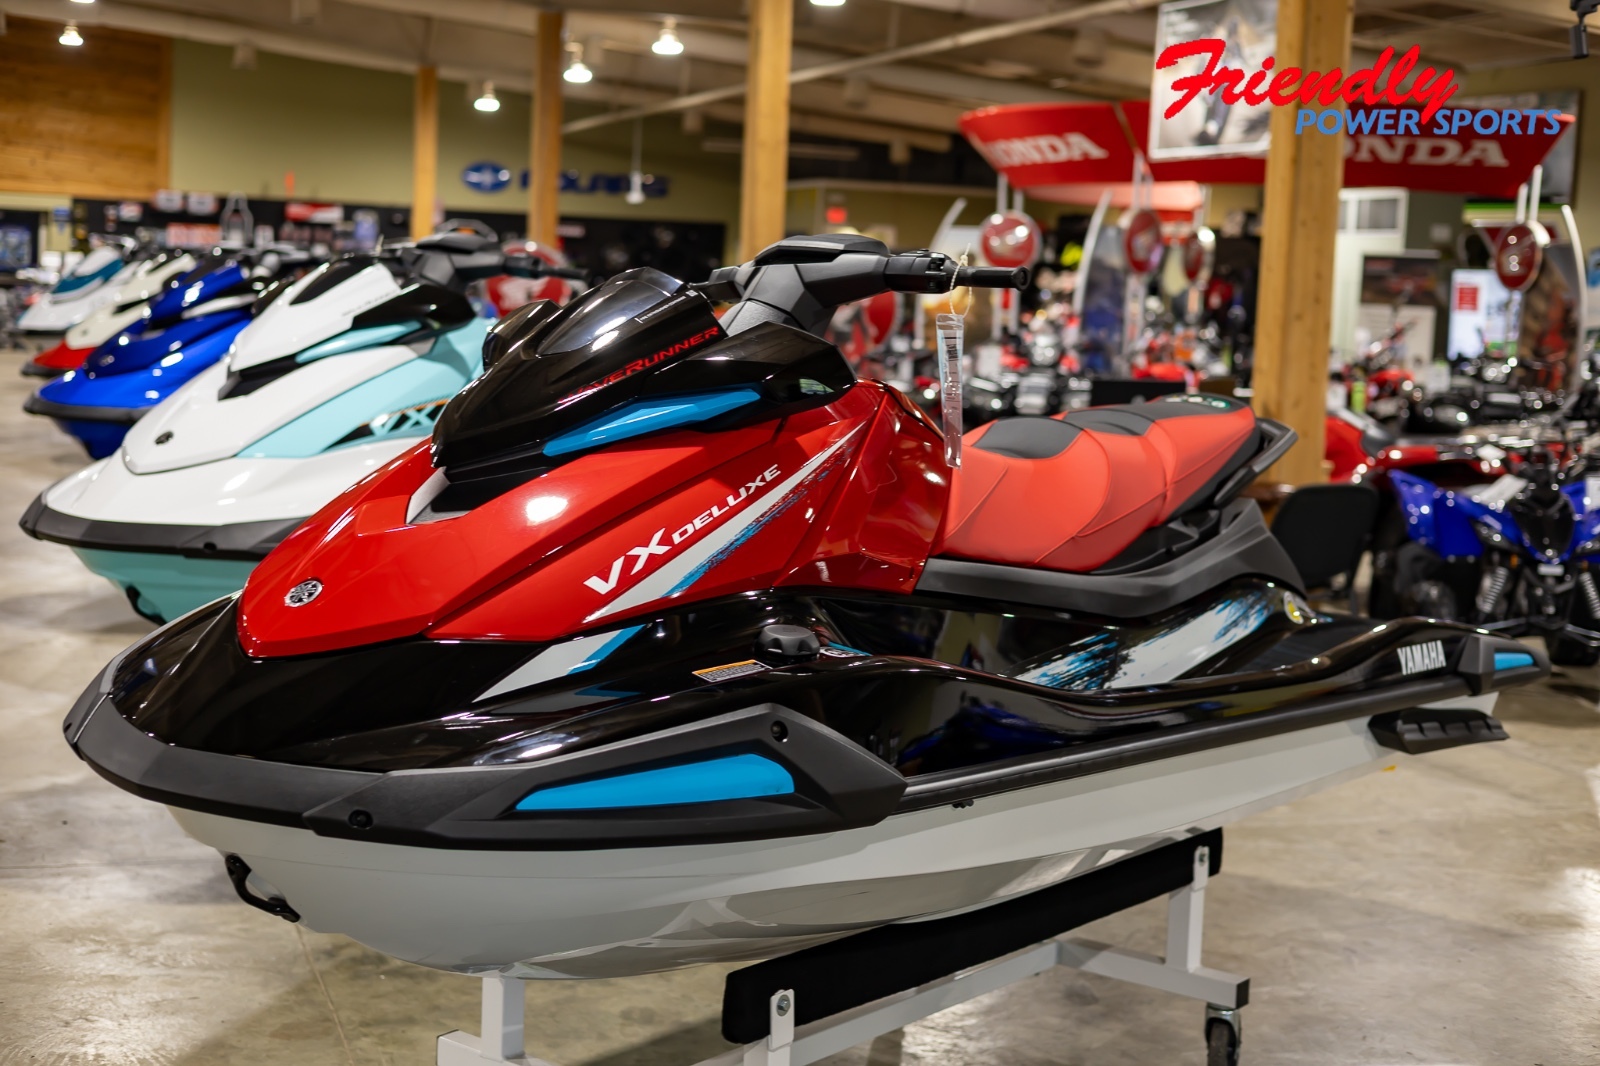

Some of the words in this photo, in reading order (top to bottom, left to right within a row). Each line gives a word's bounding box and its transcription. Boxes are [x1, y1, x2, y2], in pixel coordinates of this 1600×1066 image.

[1342, 134, 1510, 168] NDA
[583, 527, 673, 595] VX
[671, 463, 781, 545] DELUXE
[1396, 639, 1447, 676] YAMAHA
